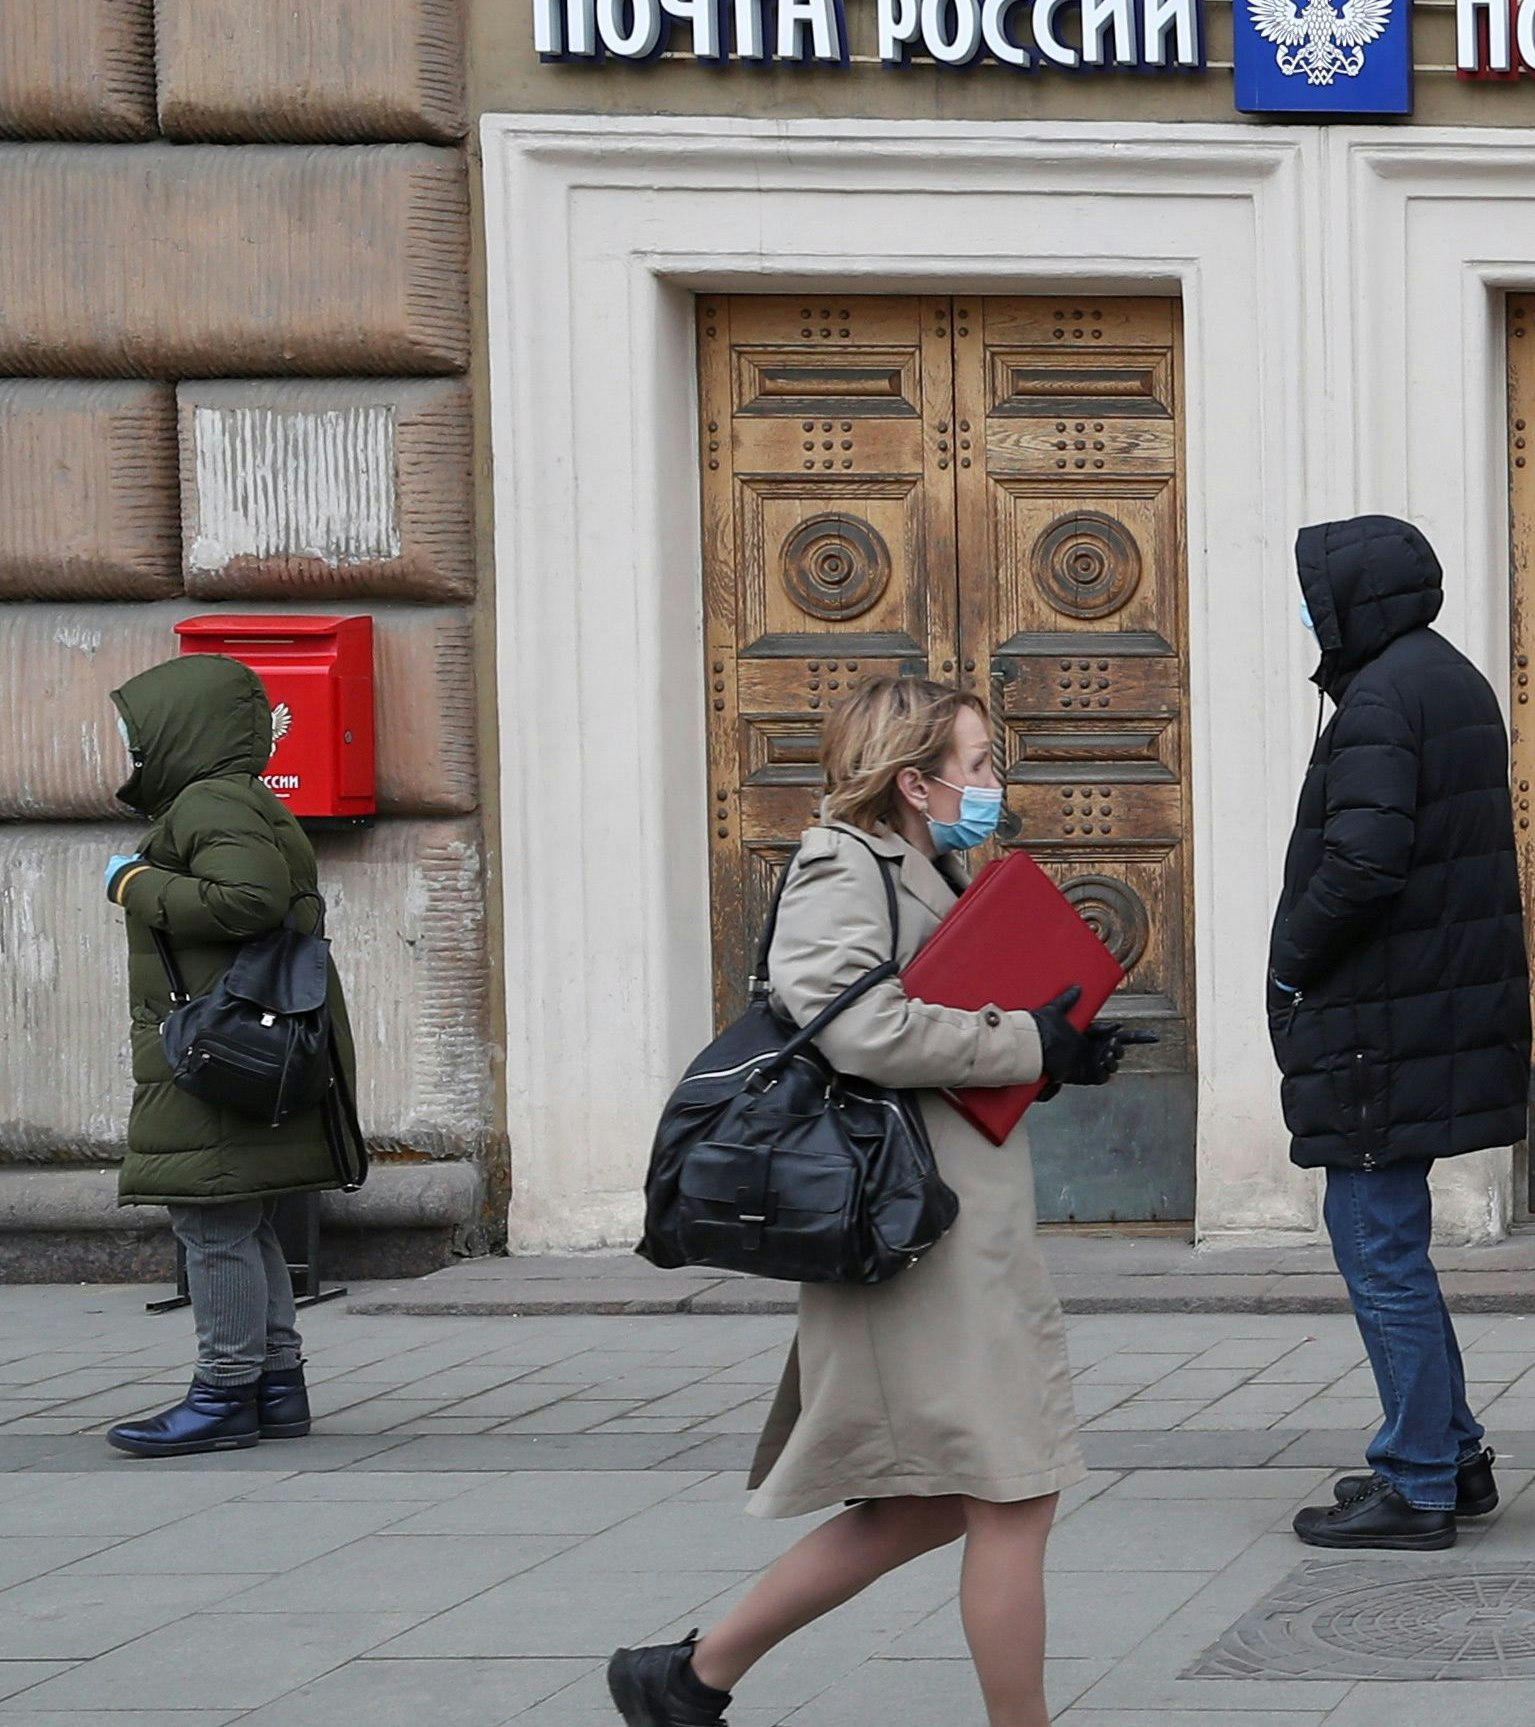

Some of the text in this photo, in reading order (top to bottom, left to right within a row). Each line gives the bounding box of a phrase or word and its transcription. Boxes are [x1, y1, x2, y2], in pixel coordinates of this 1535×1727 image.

[533, 0, 1199, 67] ПОЧТА РОССИИ
[258, 775, 299, 789] ССИИ
